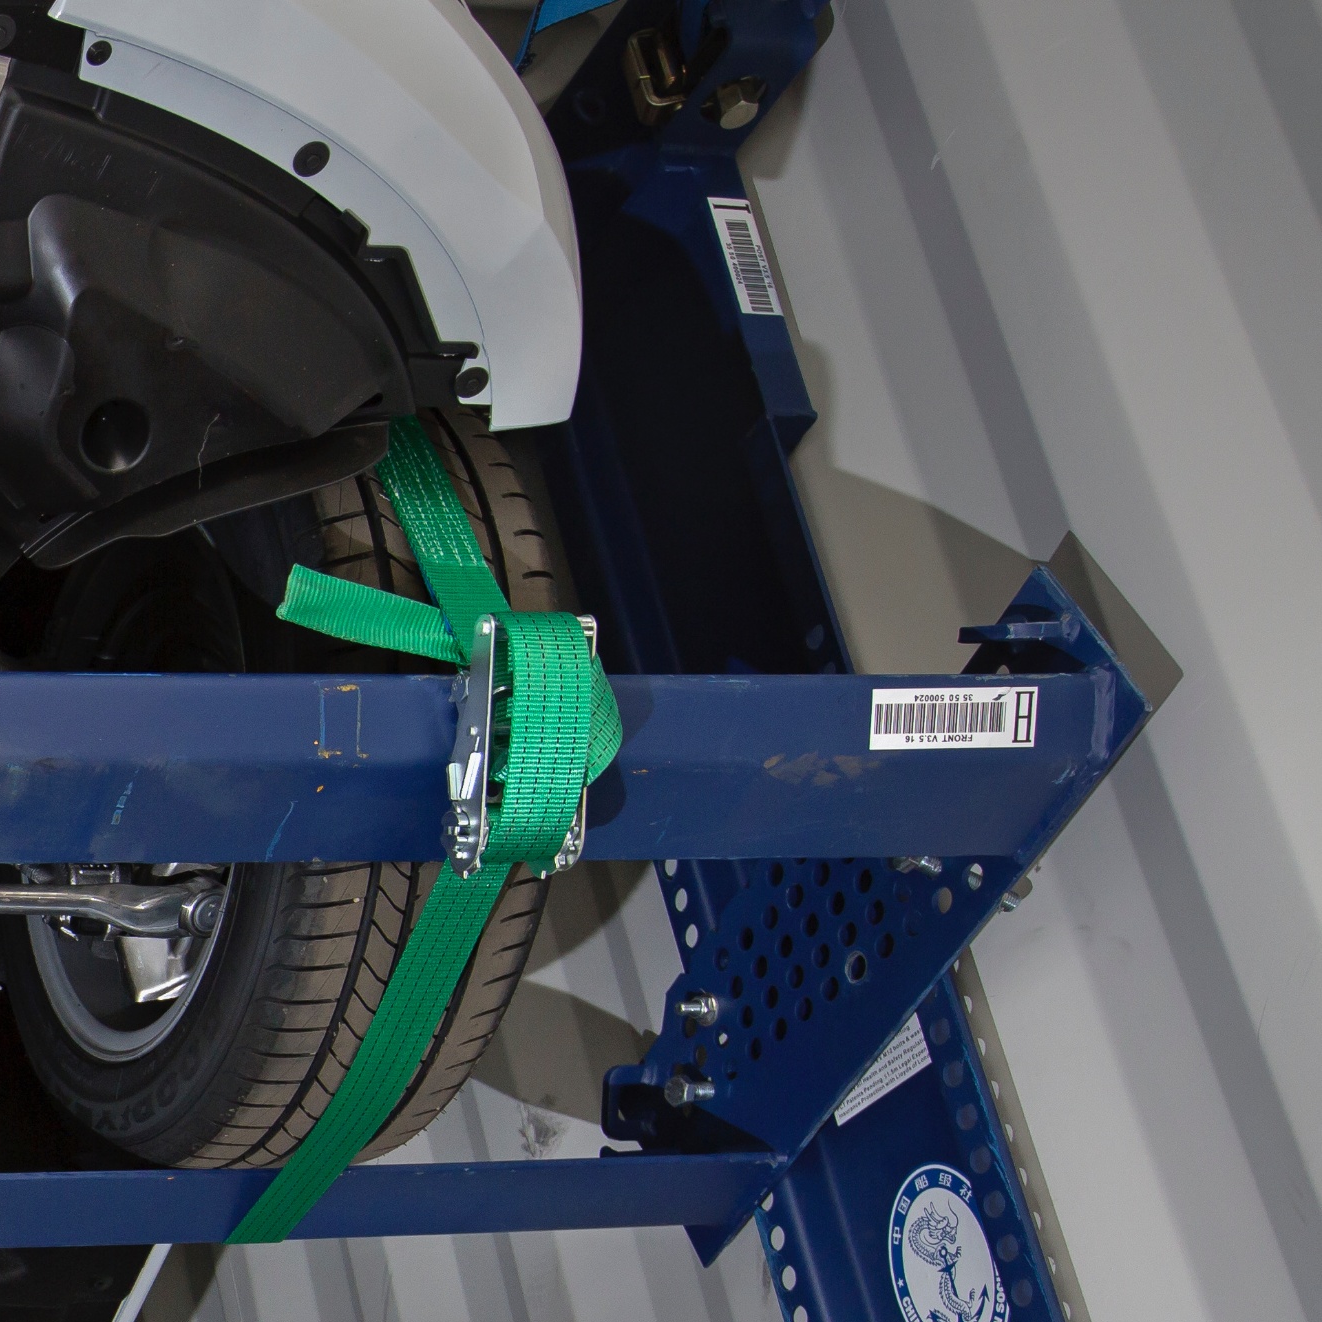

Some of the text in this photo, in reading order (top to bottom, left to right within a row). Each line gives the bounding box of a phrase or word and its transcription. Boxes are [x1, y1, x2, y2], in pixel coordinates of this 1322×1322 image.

[914, 694, 974, 702] 35 50 500024
[904, 734, 973, 743] FRONT V3.5 16
